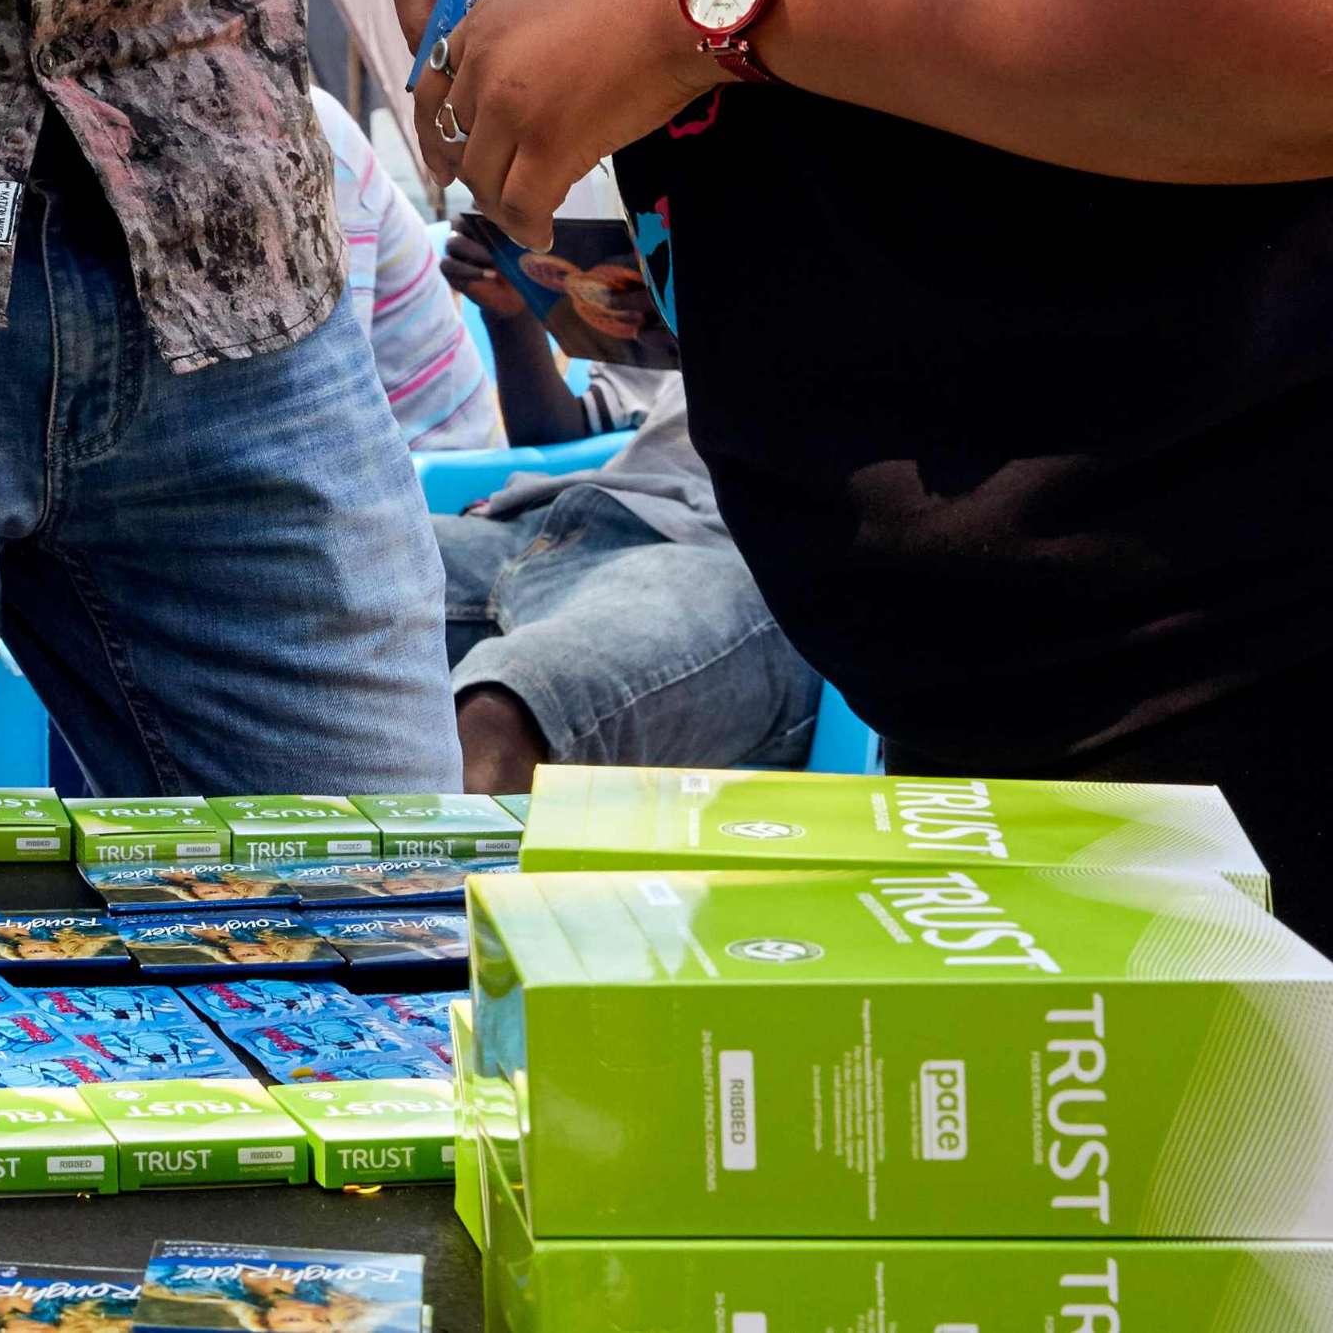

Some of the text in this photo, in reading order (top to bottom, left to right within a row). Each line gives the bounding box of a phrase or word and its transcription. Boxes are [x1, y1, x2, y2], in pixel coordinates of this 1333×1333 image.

[93, 809, 195, 817] TRUST
[242, 809, 349, 819] TRUST
[388, 809, 492, 818] TRUST
[895, 781, 1010, 859] TRUST
[96, 844, 157, 861] TRUST
[246, 841, 308, 859] TRUST
[396, 840, 457, 857] TRUST
[870, 871, 1063, 975] TRUST
[125, 1101, 262, 1116] TRUST
[730, 1078, 747, 1145] RIBBED
[924, 1069, 962, 1151] pace
[1045, 992, 1111, 1225] TRUST
[133, 1149, 212, 1172] TRUST
[250, 1151, 282, 1160] RIBBED
[337, 1147, 416, 1169] TRUST
[60, 1160, 92, 1169] RIBBED
